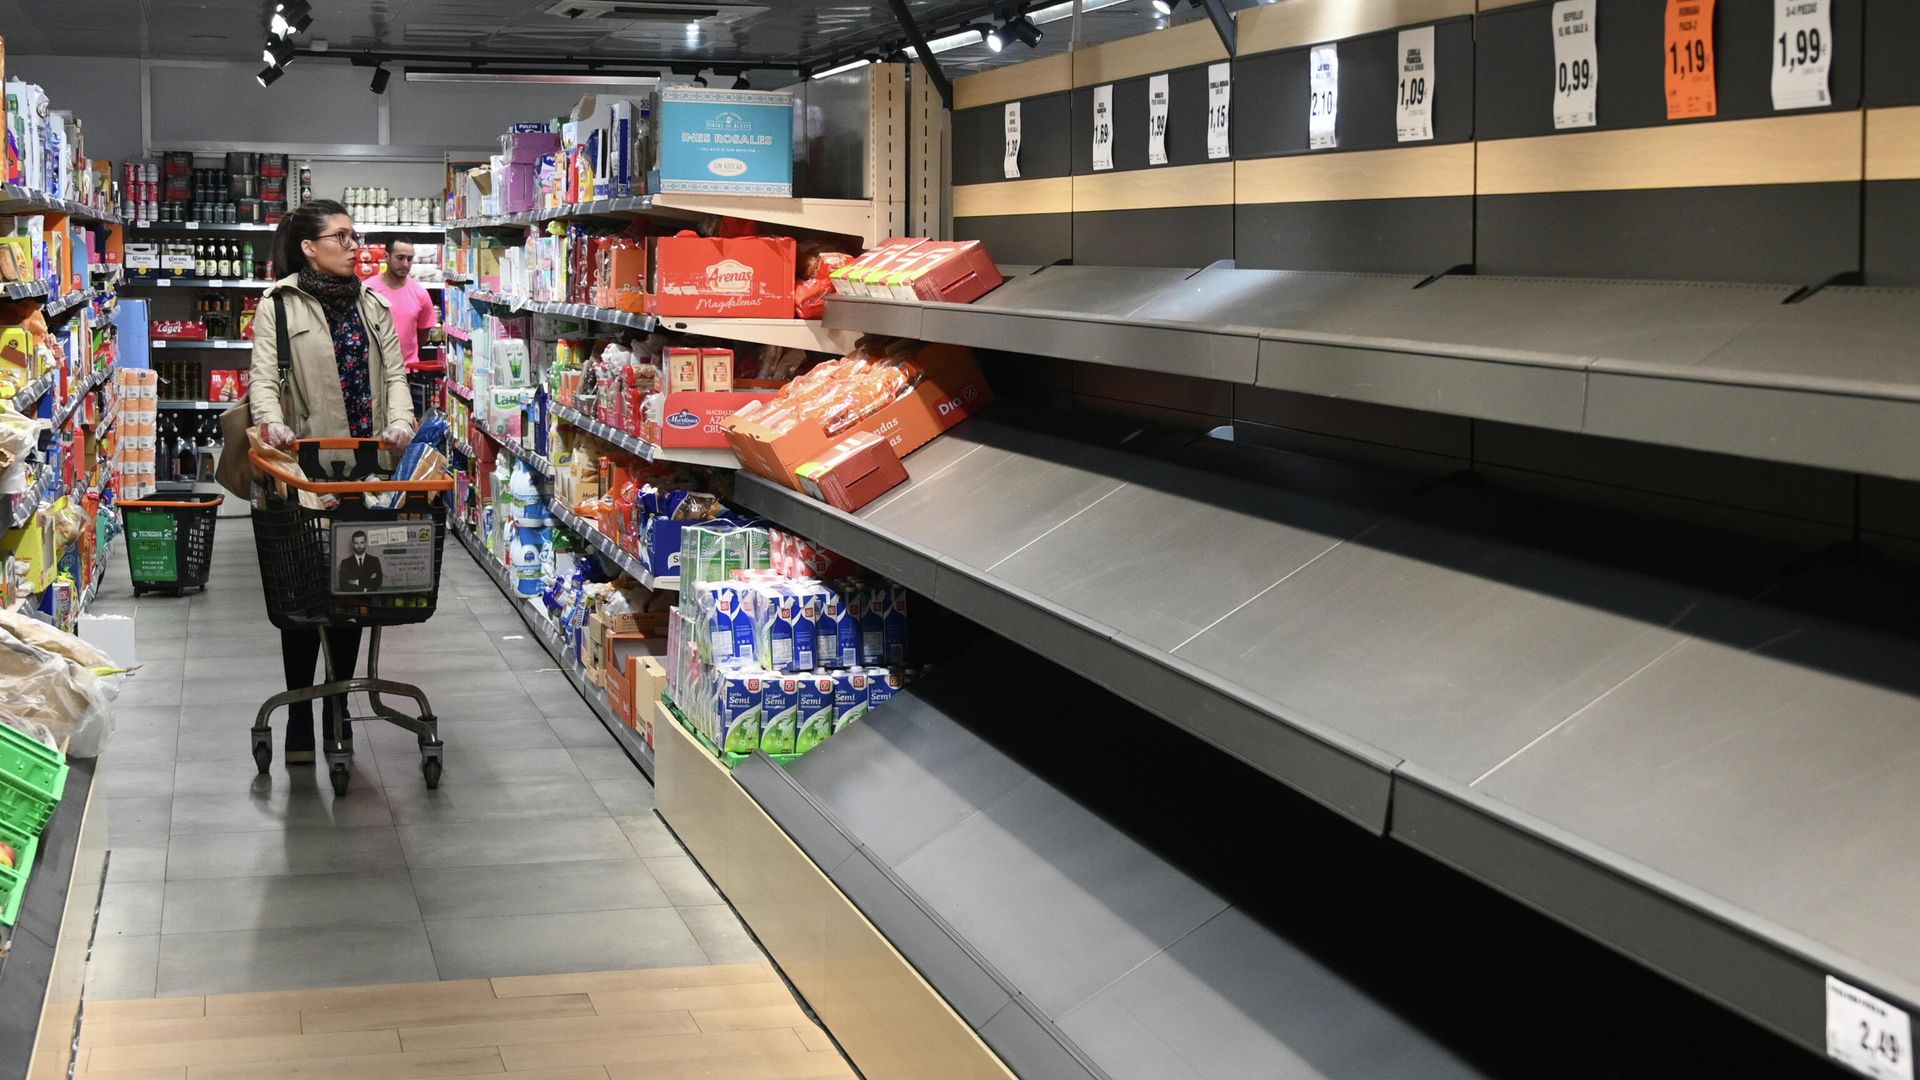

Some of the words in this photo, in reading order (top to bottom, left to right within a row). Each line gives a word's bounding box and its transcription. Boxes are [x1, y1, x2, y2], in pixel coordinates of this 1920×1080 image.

[1670, 39, 1705, 80] 1,19
[1779, 28, 1820, 73] 1,99
[1559, 59, 1589, 97] 0,99
[1400, 77, 1425, 110] 1,09
[1151, 115, 1165, 141] 1,99
[1210, 105, 1226, 133] 1,15
[681, 132, 711, 143] INES
[714, 133, 774, 146] ROSALES
[1094, 124, 1108, 148] 1,69
[706, 267, 751, 285] Arenas
[695, 296, 763, 313] Magdalenas
[157, 325, 183, 333] Lager
[729, 696, 750, 704] Semi
[764, 697, 786, 705] Semi
[800, 697, 821, 705] Semi
[835, 693, 856, 701] Semi
